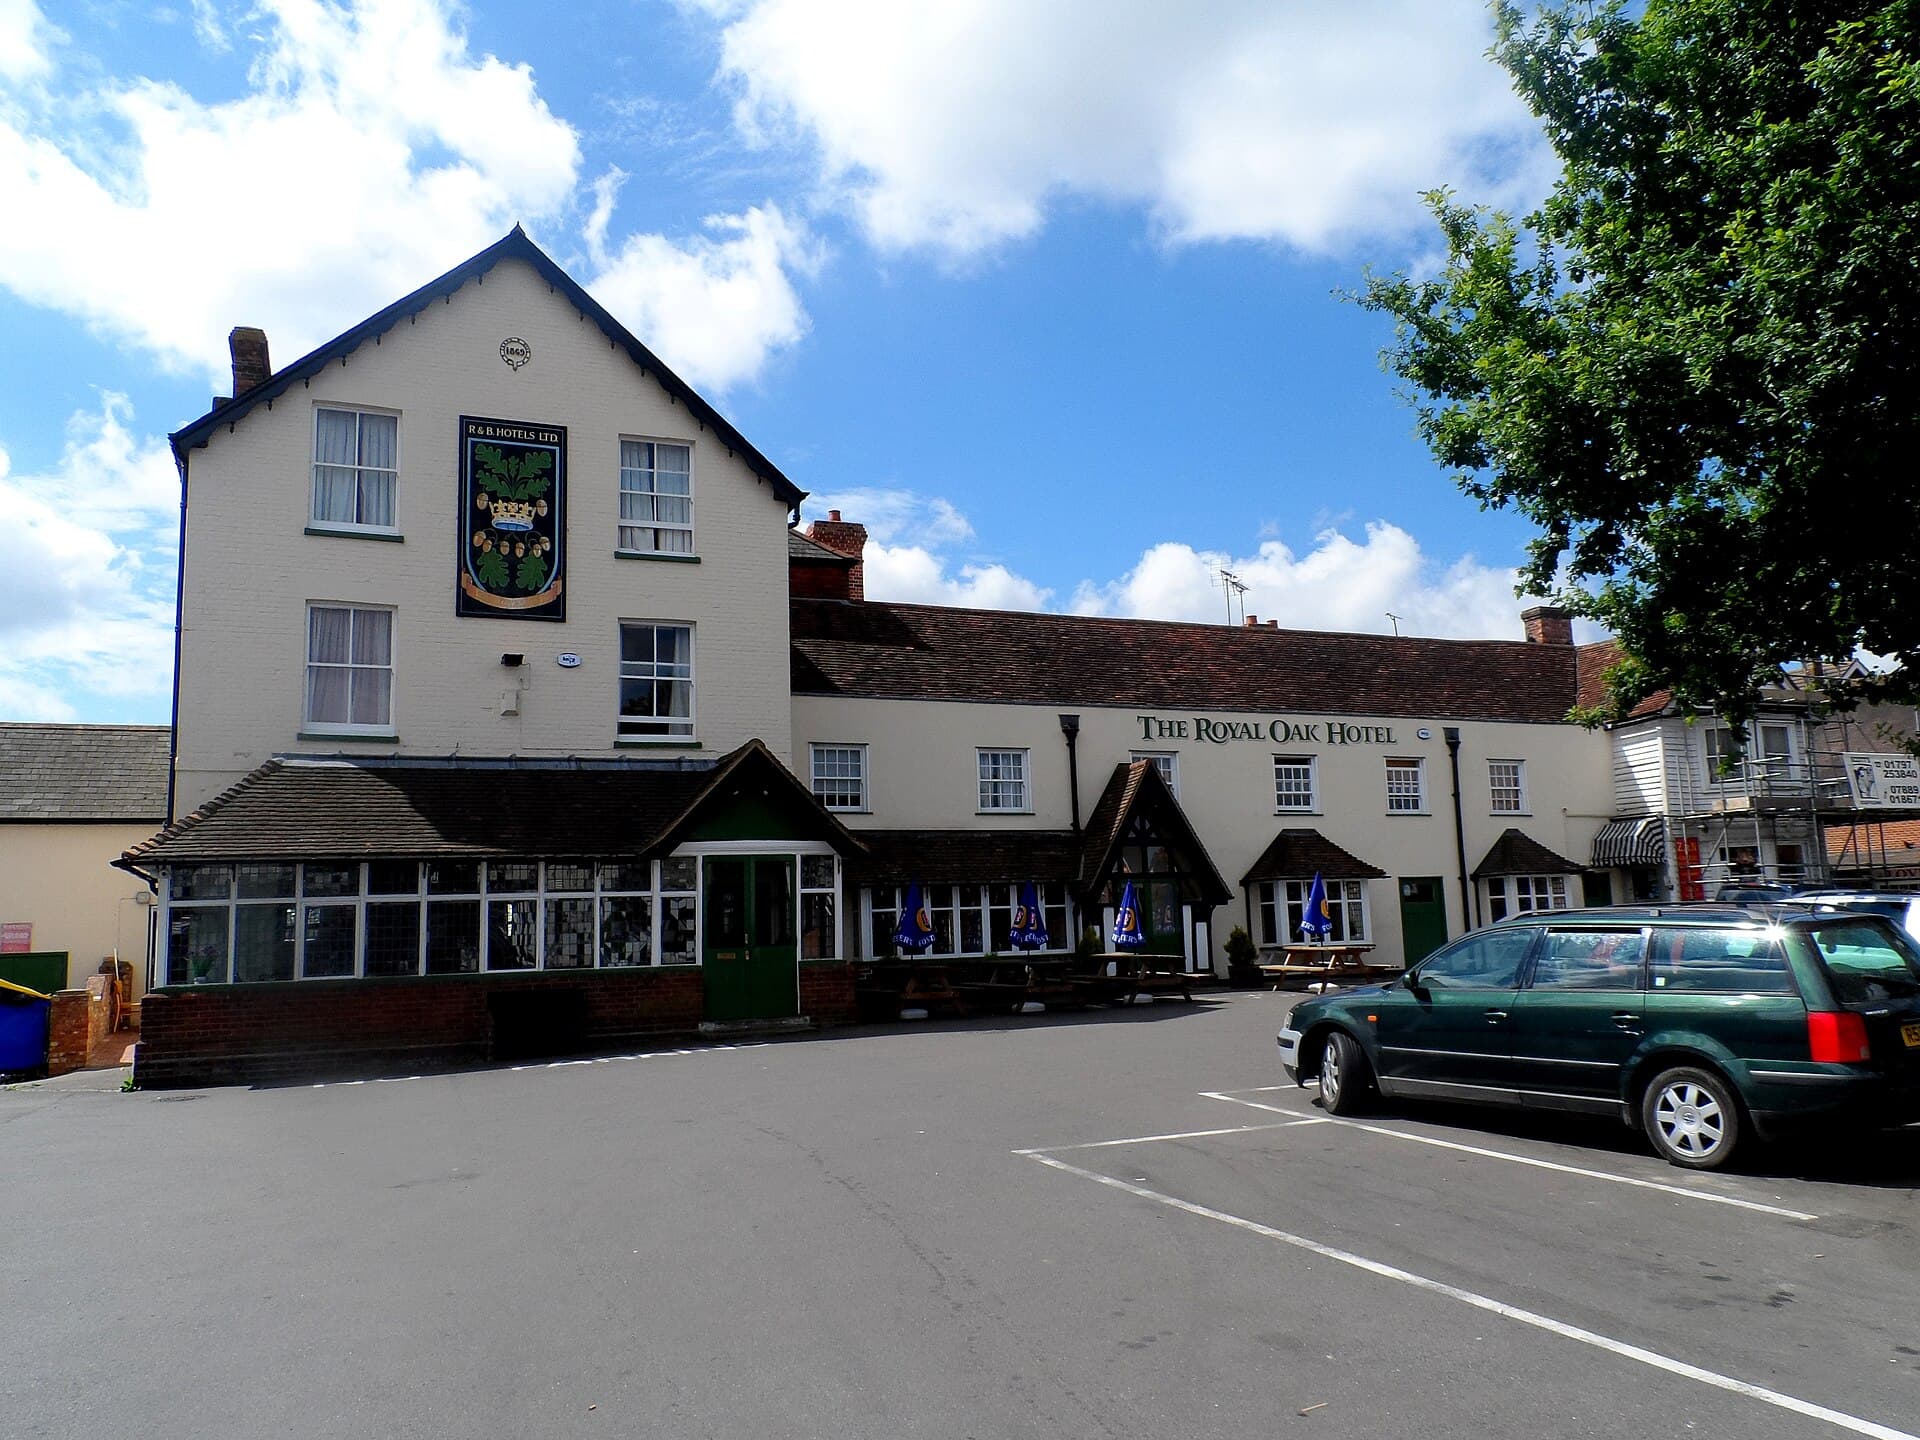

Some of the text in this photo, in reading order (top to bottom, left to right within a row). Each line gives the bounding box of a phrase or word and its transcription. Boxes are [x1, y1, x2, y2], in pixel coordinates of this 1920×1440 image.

[468, 424, 476, 434] R
[477, 426, 485, 435] &
[496, 428, 535, 440] HOTELS
[1136, 715, 1397, 745] THE ROYAL OAK HOTEL
[1883, 760, 1912, 769] 01797
[1882, 769, 1918, 778] 253840
